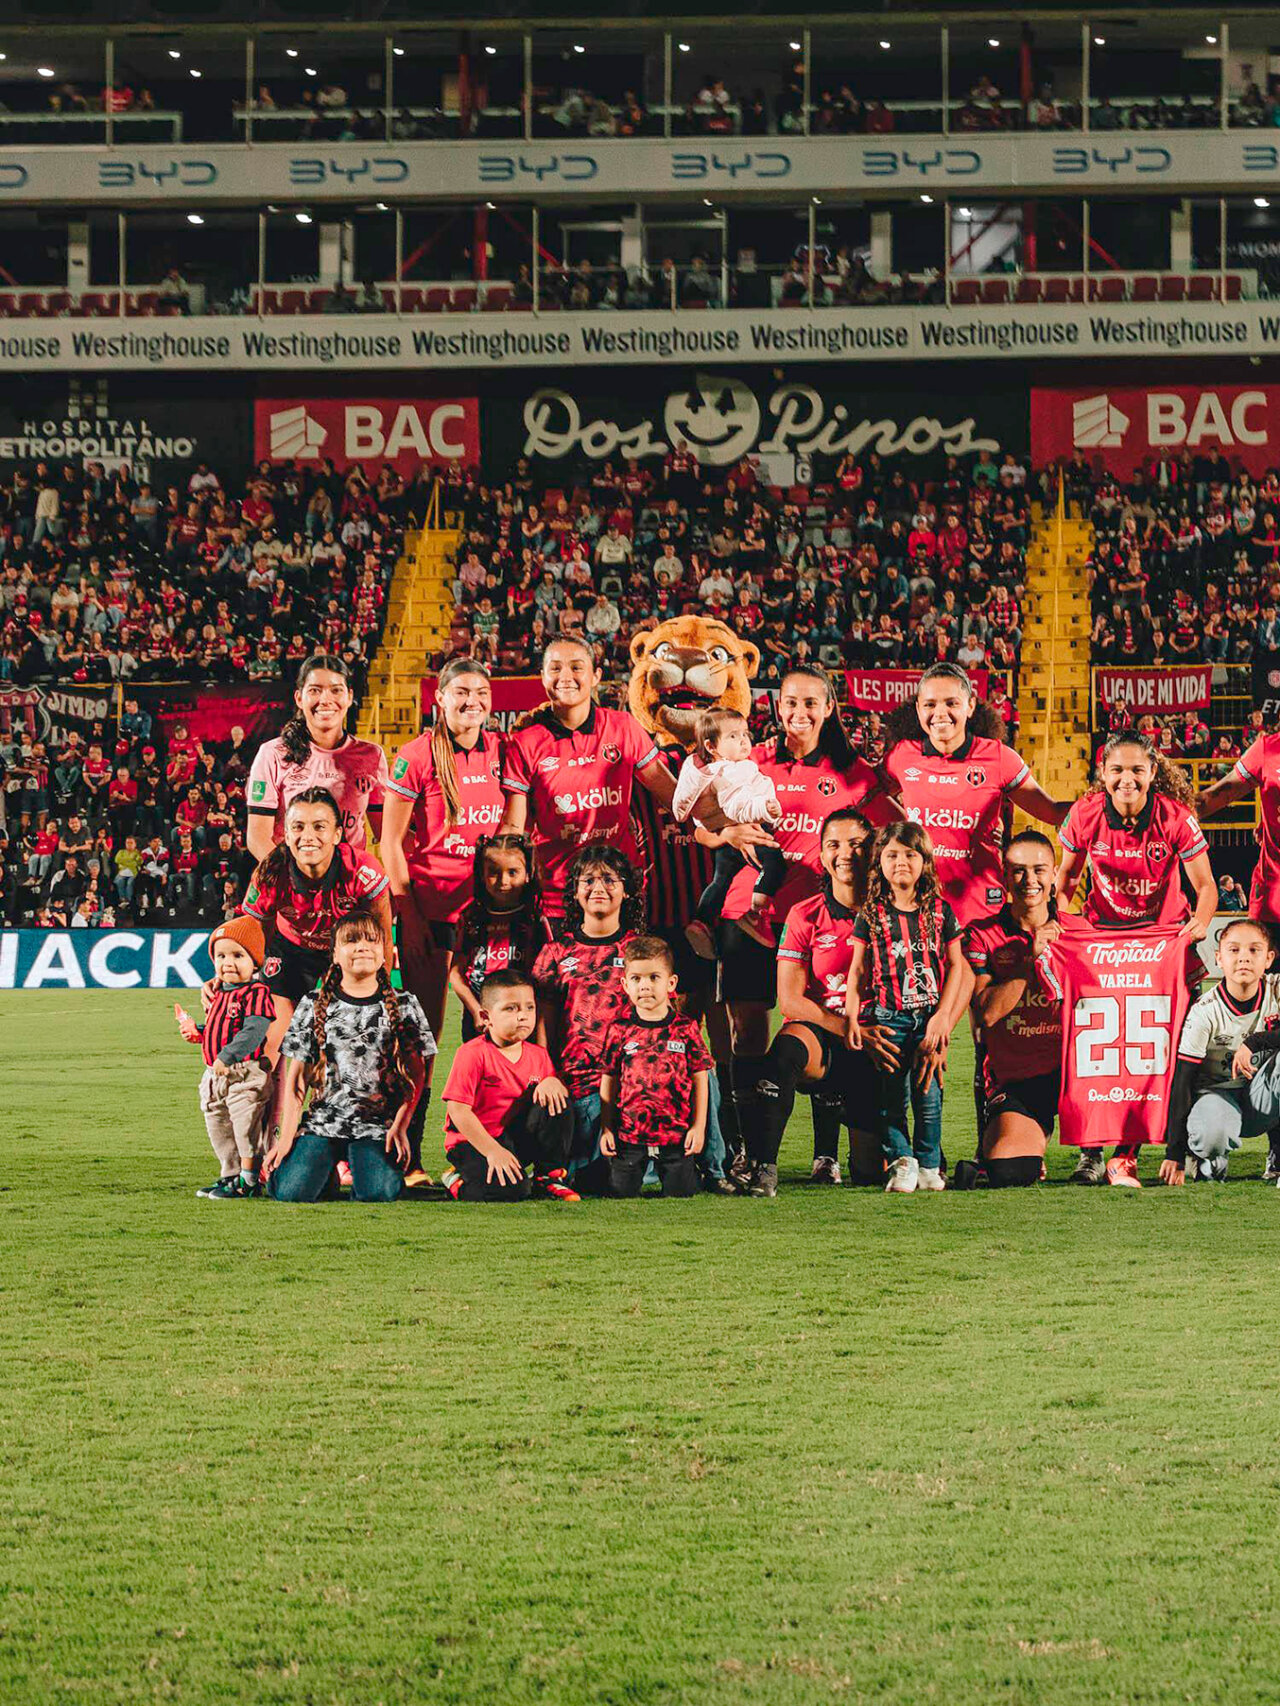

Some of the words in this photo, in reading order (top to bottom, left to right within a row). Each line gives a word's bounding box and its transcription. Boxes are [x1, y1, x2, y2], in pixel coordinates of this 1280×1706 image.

[290, 157, 409, 184] BYD
[479, 154, 598, 181] BYD
[671, 153, 791, 179] BYD
[862, 149, 982, 176] BYD
[1052, 146, 1172, 173] BYD
[99, 160, 218, 187] BYD
[73, 330, 230, 363] Westinghouse
[242, 329, 400, 361] Westinghouse
[412, 328, 570, 360] Westinghouse
[582, 325, 739, 358] Westinghouse
[751, 323, 909, 354] Westinghouse
[921, 319, 1079, 351] Westinghouse
[1090, 317, 1247, 349] Westinghouse
[24, 420, 153, 436] HOSPITAL
[345, 405, 465, 457] BAC
[522, 389, 668, 459] Dos
[758, 384, 1000, 456] Pinos
[1147, 393, 1268, 446] BAC
[0, 436, 194, 459] ETROPOLITANO
[1103, 676, 1135, 703] LIGA
[1137, 679, 1155, 706] DE
[1156, 677, 1173, 704] MI
[1175, 674, 1207, 703] VIDA
[47, 691, 108, 720] JIMBO
[577, 755, 597, 766] BAC
[471, 775, 488, 784] BAC
[787, 784, 807, 792] BAC
[939, 776, 958, 784] BAC
[576, 785, 623, 812] kölbi
[925, 807, 980, 830] kölbi
[1124, 850, 1143, 858] BAC
[1086, 939, 1168, 967] Tropical
[1098, 974, 1152, 988] VARELA
[1075, 994, 1172, 1078] 25
[1088, 1088, 1110, 1101] Dos
